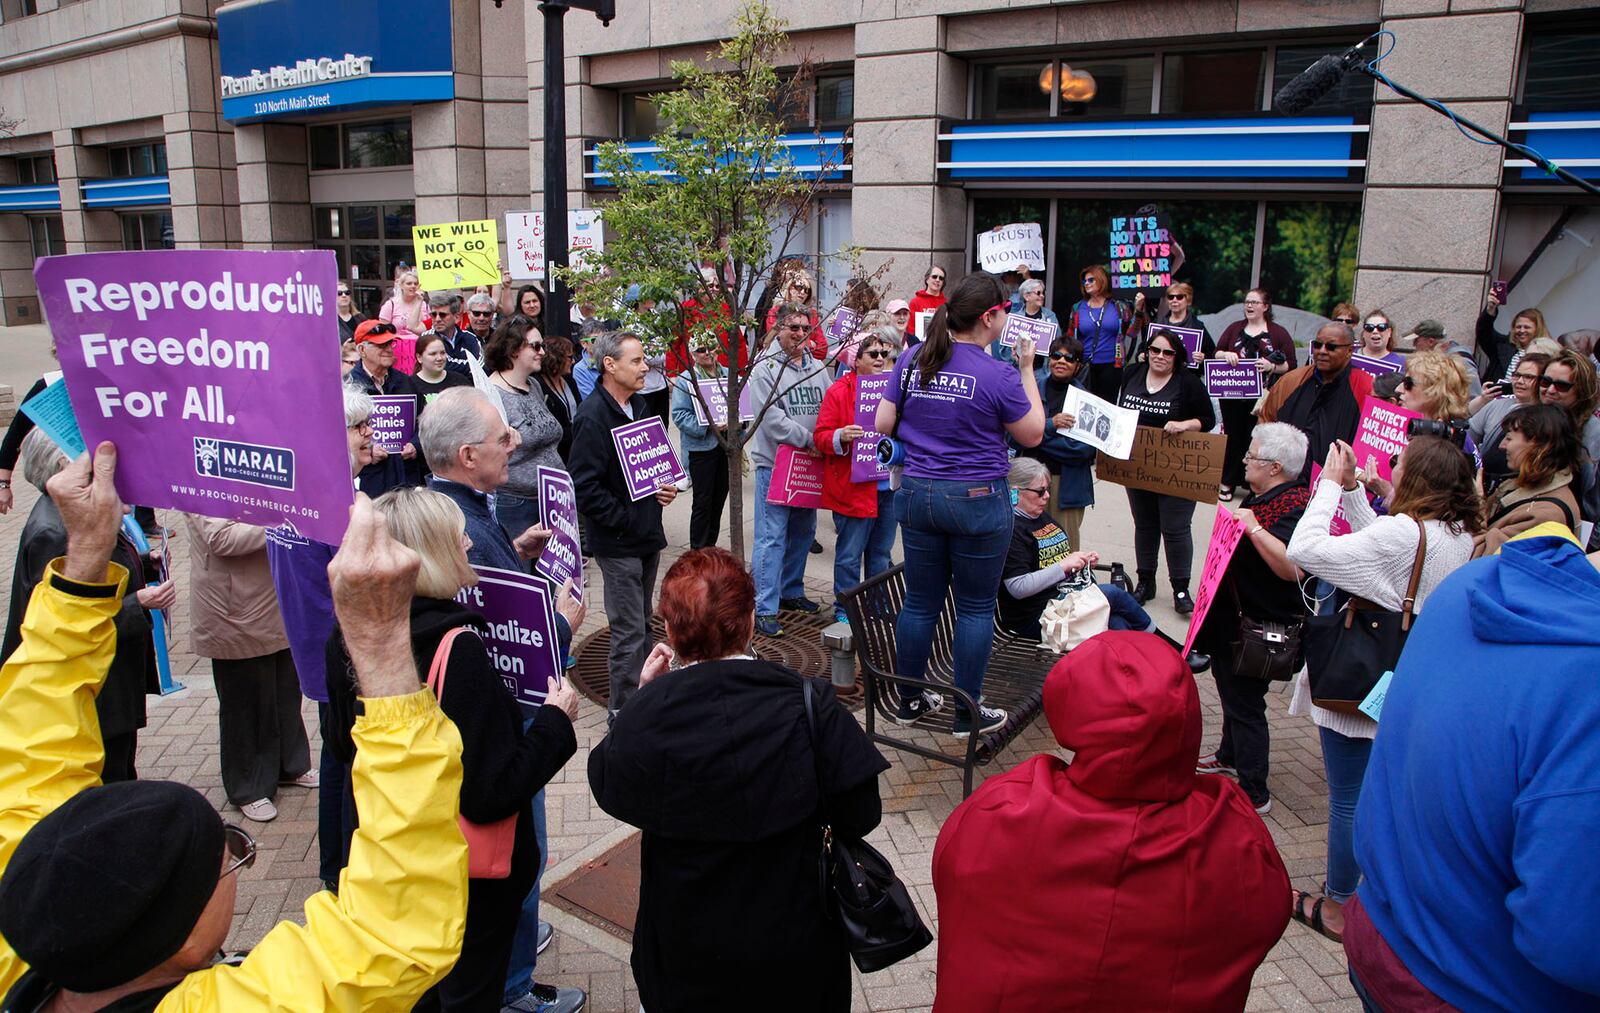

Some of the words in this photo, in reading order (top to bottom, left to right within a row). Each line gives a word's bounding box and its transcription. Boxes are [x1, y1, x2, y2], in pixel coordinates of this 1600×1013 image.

[221, 69, 271, 96] Premier
[271, 58, 318, 88] Health
[317, 54, 373, 80] Center
[254, 101, 267, 114] 110
[268, 98, 288, 112] North
[289, 95, 307, 110] Main
[308, 93, 330, 107] Street
[523, 215, 528, 227] I
[1112, 217, 1126, 231] IF
[1129, 216, 1157, 231] IT'S
[417, 227, 441, 239] WE
[451, 223, 489, 236] WILL
[990, 228, 1034, 244] TRUST
[1110, 231, 1136, 245] NOT
[1137, 229, 1169, 244] YOUR
[425, 242, 455, 255] NOT
[464, 240, 485, 251] GO
[572, 236, 592, 246] ZERO
[985, 249, 1041, 266] WOMEN
[1110, 244, 1141, 258] BODY
[1144, 243, 1170, 257] IT'S
[422, 257, 464, 270] BACK
[1111, 259, 1136, 273] NOT
[1137, 258, 1169, 272] YOUR
[1112, 273, 1171, 288] DECISION
[64, 271, 324, 321] Reproductive
[1020, 322, 1032, 331] my
[1033, 324, 1051, 334] local
[80, 328, 270, 371] Freedom
[1211, 368, 1245, 377] Abortion
[1247, 368, 1255, 377] is
[928, 374, 969, 391] ARAL
[1211, 378, 1256, 387] Healthcare
[860, 391, 882, 401] Free
[94, 386, 168, 419] For
[181, 384, 236, 426] All.
[372, 404, 401, 417] Keep
[859, 404, 876, 413] For
[1371, 406, 1407, 428] PROTECT
[1362, 417, 1381, 436] SAFE,
[372, 430, 402, 442] Open
[623, 431, 650, 450] Don't
[1161, 430, 1210, 450] PREMIER
[1360, 431, 1405, 455] ABORTION
[628, 442, 670, 466] Criminalize
[857, 442, 878, 451] Pro-
[223, 447, 288, 475] NARAL
[795, 458, 814, 467] STAND
[856, 453, 876, 463] Pro-
[1144, 448, 1210, 475] PISSED
[225, 467, 260, 478] PRO-CHOICE
[261, 473, 288, 482] AMERICA
[634, 460, 672, 483] Abortion
[793, 465, 808, 474] WITH
[792, 473, 818, 483] PLANNED
[790, 481, 825, 492] PARENTHOO
[171, 484, 320, 520] WWW.PROCHOICEAMERICA.ORG
[548, 484, 571, 510] Don't
[546, 534, 576, 571] Abortion
